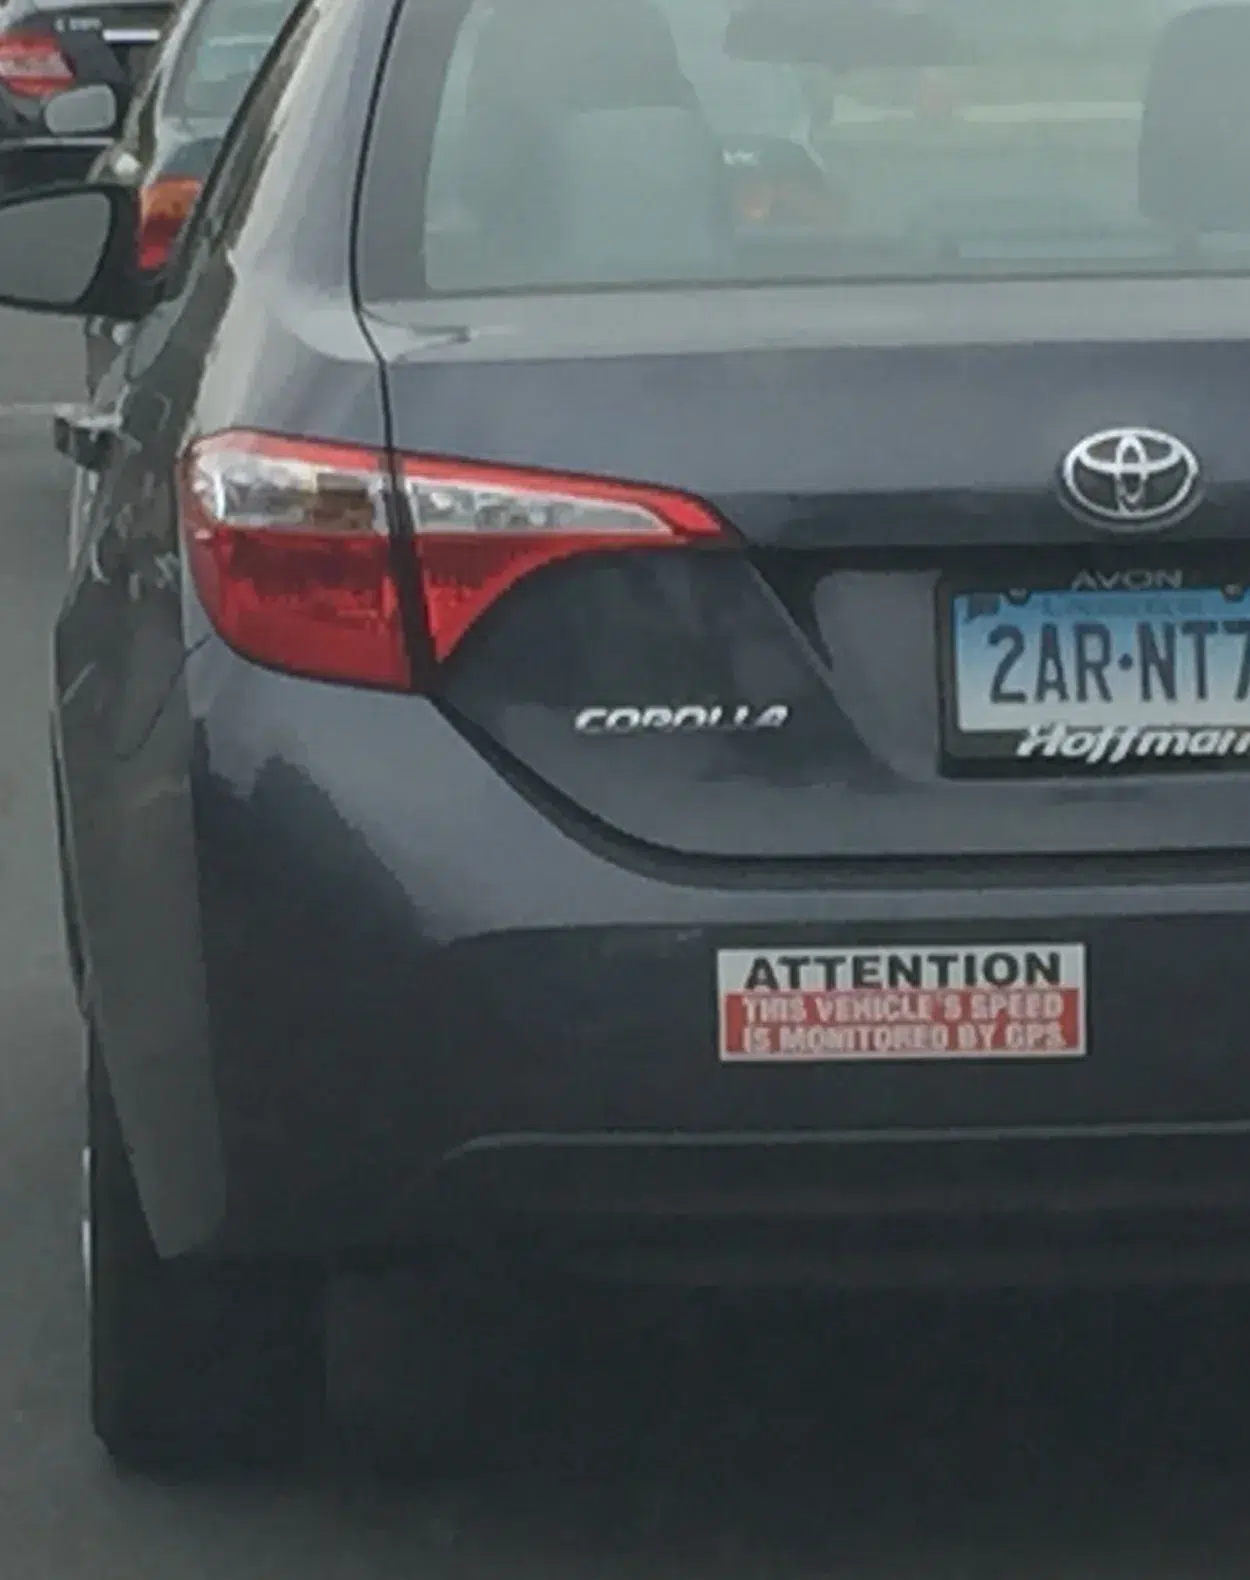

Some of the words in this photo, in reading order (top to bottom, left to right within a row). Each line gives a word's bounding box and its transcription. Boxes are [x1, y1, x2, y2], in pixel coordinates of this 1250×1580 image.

[1071, 568, 1184, 590] AVON
[573, 704, 790, 734] COROLLA
[744, 952, 1063, 991] ATTENTION
[742, 994, 807, 1024] THIS
[814, 992, 963, 1023] VEHICLE'S
[970, 991, 1064, 1020] SPEED
[742, 1024, 771, 1053] IS
[778, 1023, 949, 1053] MONITORED
[957, 1023, 997, 1050] BY
